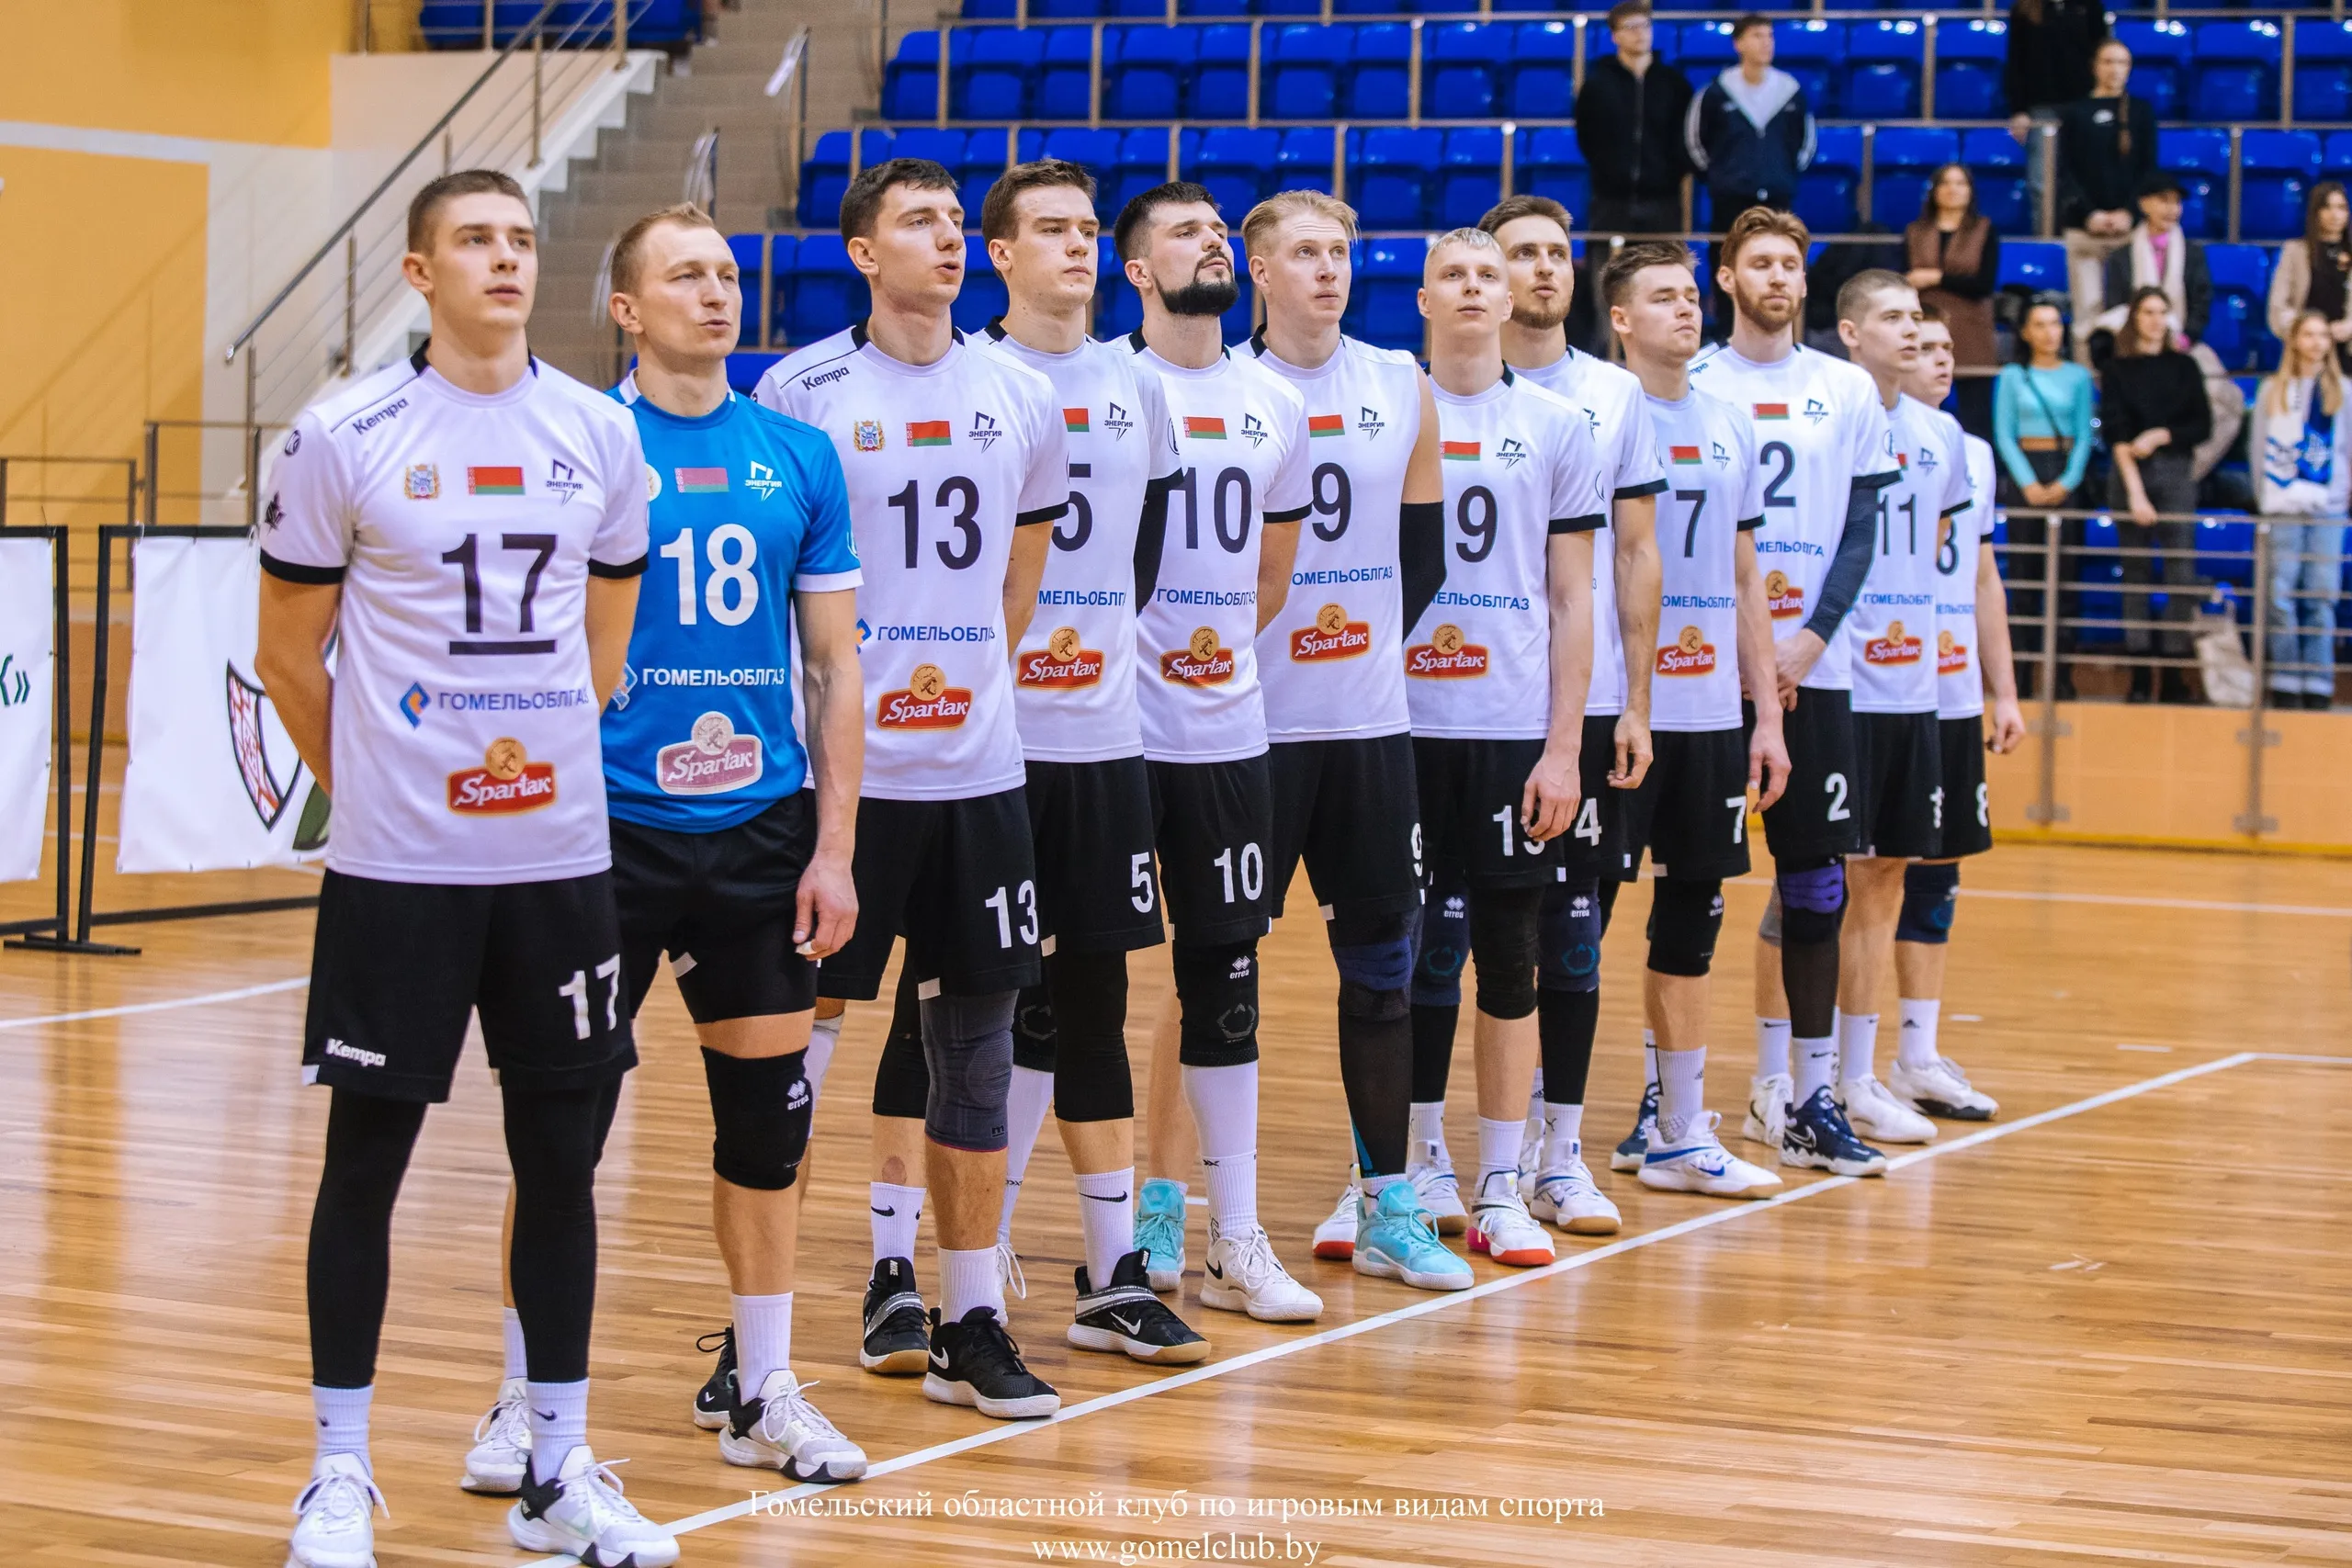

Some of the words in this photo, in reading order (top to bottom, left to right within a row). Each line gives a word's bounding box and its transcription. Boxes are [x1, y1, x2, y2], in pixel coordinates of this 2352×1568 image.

[801, 366, 850, 390] Kempa
[353, 397, 409, 435] Kempa
[1240, 429, 1268, 438] ЭНЕРГИЯ
[968, 430, 1002, 439] ЭНЕРГИЯ
[546, 479, 583, 491] ЭНЕРГИЯ
[745, 479, 782, 488] ЭНЕРГИЯ
[1759, 441, 1796, 507] 2
[1051, 464, 1093, 552] 5
[1169, 467, 1252, 554] 10
[1311, 462, 1351, 542] 9
[888, 476, 982, 570] 13
[1455, 485, 1498, 563] 9
[1676, 490, 1707, 558] 7
[1876, 493, 1916, 555] 11
[442, 533, 558, 634] 17
[660, 524, 759, 626] 18
[1292, 566, 1393, 585] ОМЕЛЬОБЛГАЗ
[1038, 590, 1126, 606] МЕЛЬОБЛГ
[1295, 629, 1367, 658] Spartak
[1410, 649, 1485, 673] Spartak
[1659, 648, 1714, 671] Spartak
[642, 668, 786, 686] ГОМЕЛЬОБЛГАЗ
[1022, 655, 1100, 682] Spartak
[1166, 655, 1232, 680] Spartak
[882, 694, 969, 723] Spartak
[667, 749, 753, 782] Spartak
[454, 773, 552, 807] Spartak
[1824, 773, 1850, 822] 2
[1575, 798, 1602, 846] 4
[1725, 795, 1747, 844] 7
[1131, 852, 1154, 913] 5
[1214, 842, 1263, 903] 10
[985, 879, 1039, 948] 13
[559, 953, 620, 1040] 17
[326, 1038, 386, 1067] Kempa
[889, 1259, 899, 1276] NIKE
